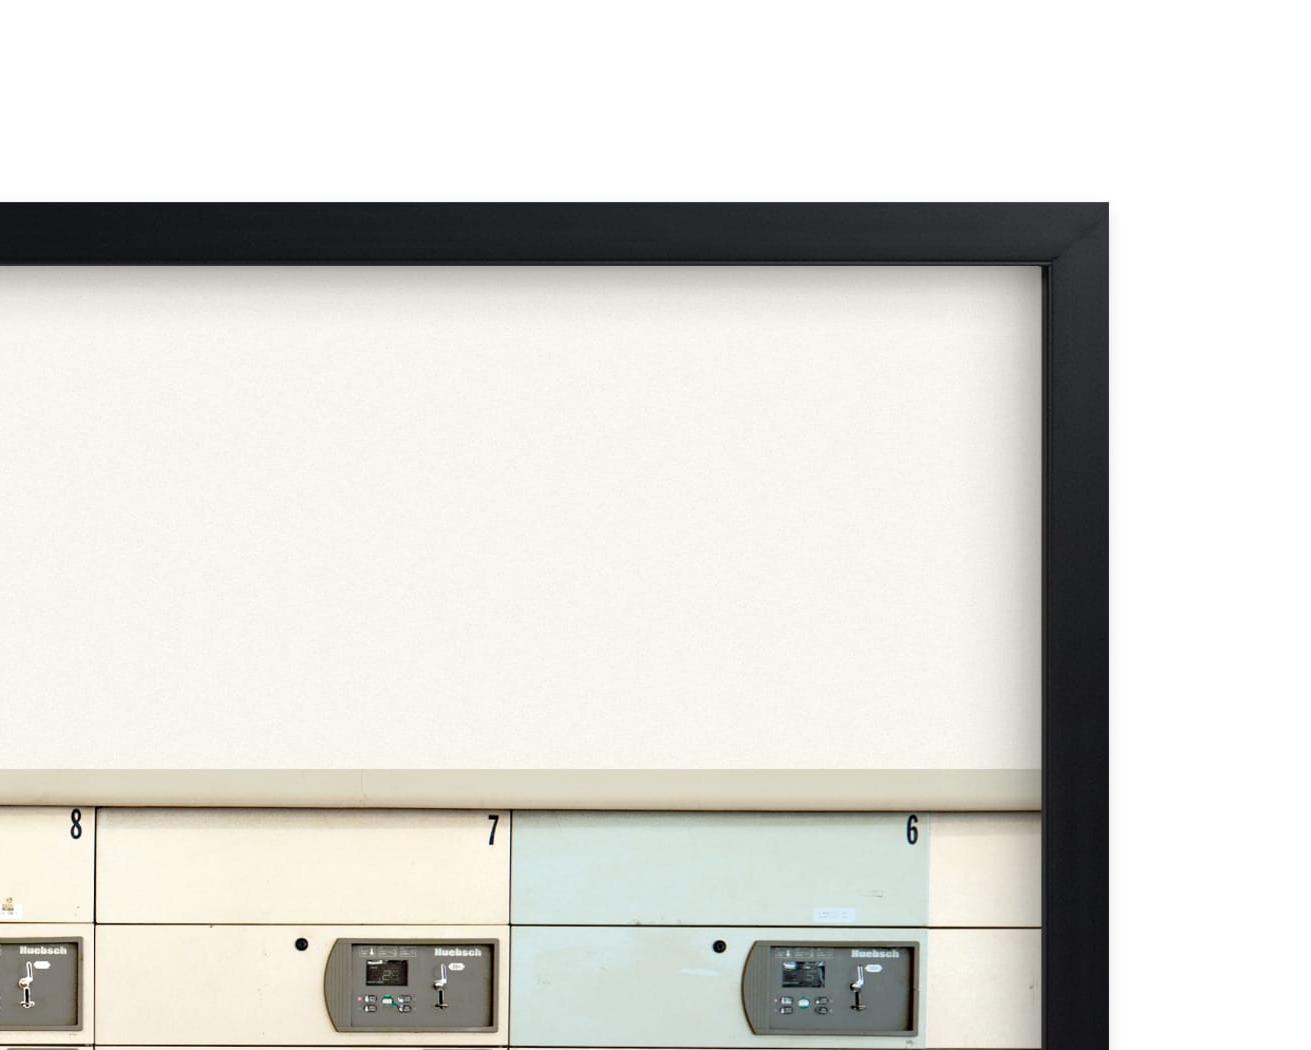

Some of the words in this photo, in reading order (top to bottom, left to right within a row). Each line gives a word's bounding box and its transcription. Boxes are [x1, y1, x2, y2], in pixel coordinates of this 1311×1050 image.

[70, 808, 83, 840] 8
[487, 814, 500, 846] 7
[906, 814, 919, 846] 6
[19, 945, 68, 956] Huebsch
[434, 947, 482, 957] Huebsch
[851, 948, 900, 958] Huebsch
